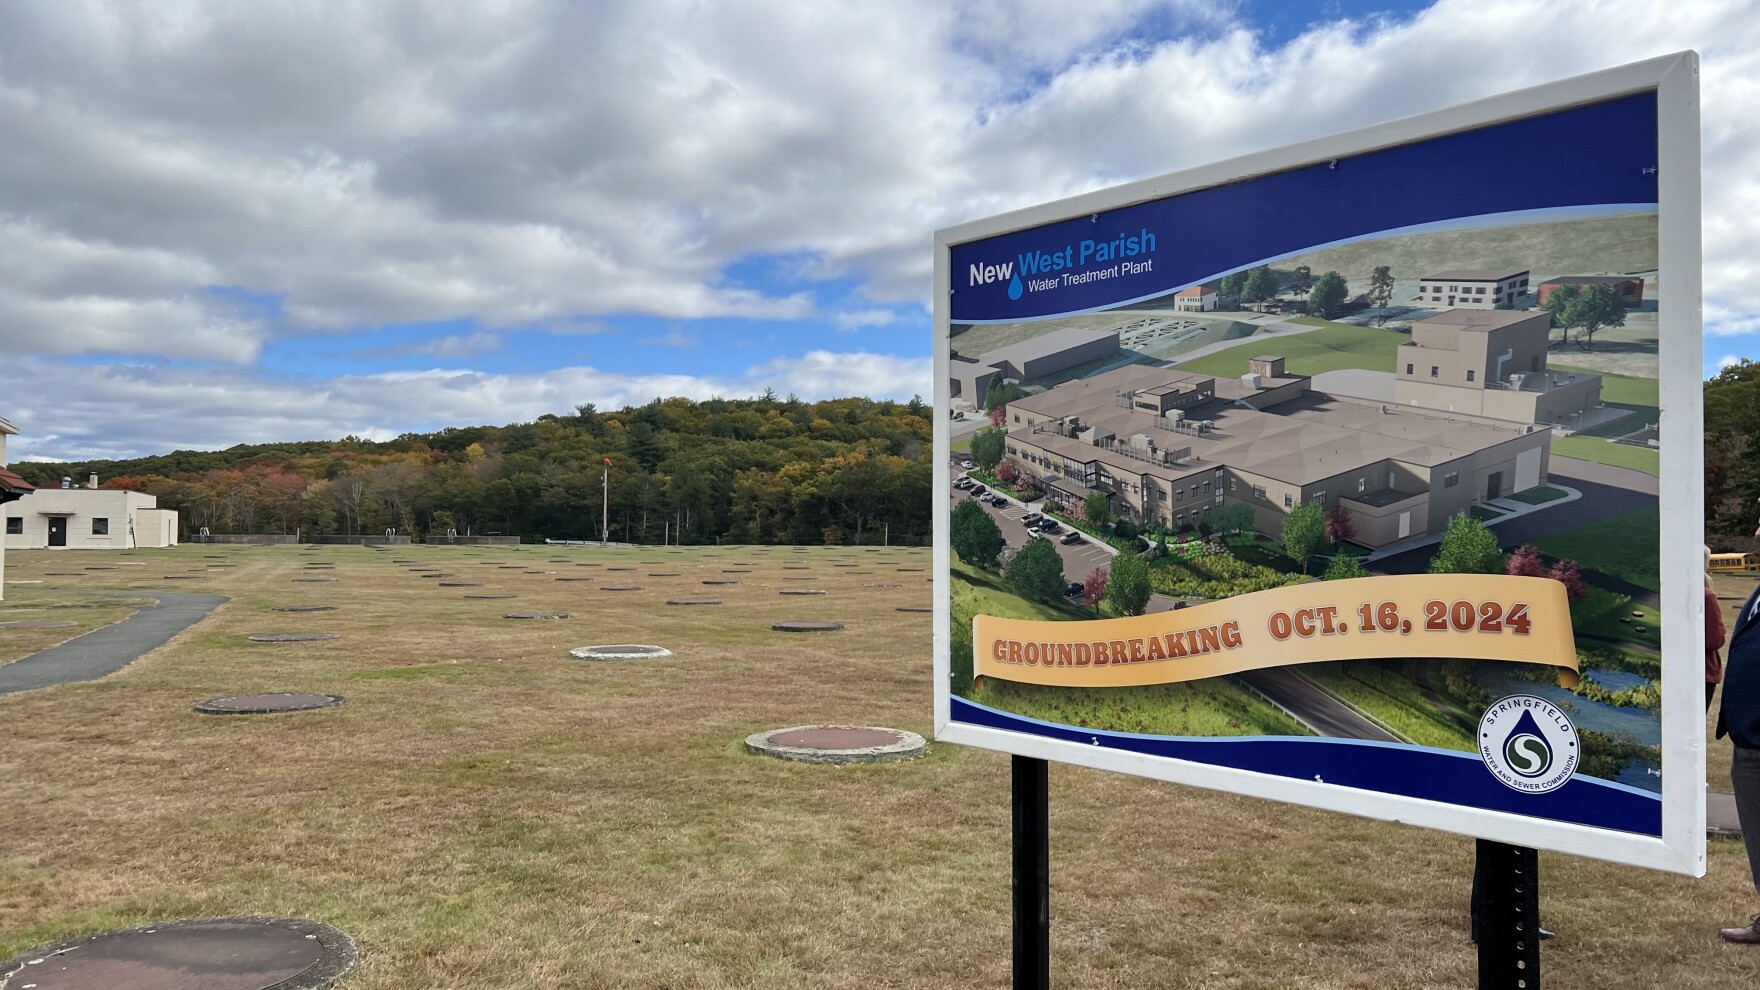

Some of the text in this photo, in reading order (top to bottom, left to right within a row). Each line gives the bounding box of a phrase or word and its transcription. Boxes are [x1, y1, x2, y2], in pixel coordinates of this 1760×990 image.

[969, 228, 1156, 287] New West Parish
[1028, 259, 1153, 293] Water Treatment Plant
[992, 600, 1532, 667] GROUNDBREAKING OCT. 16, 2024
[1486, 699, 1570, 732] SPRINGFIELD
[1483, 745, 1575, 790] WATER AND SEWER COMMISSION
